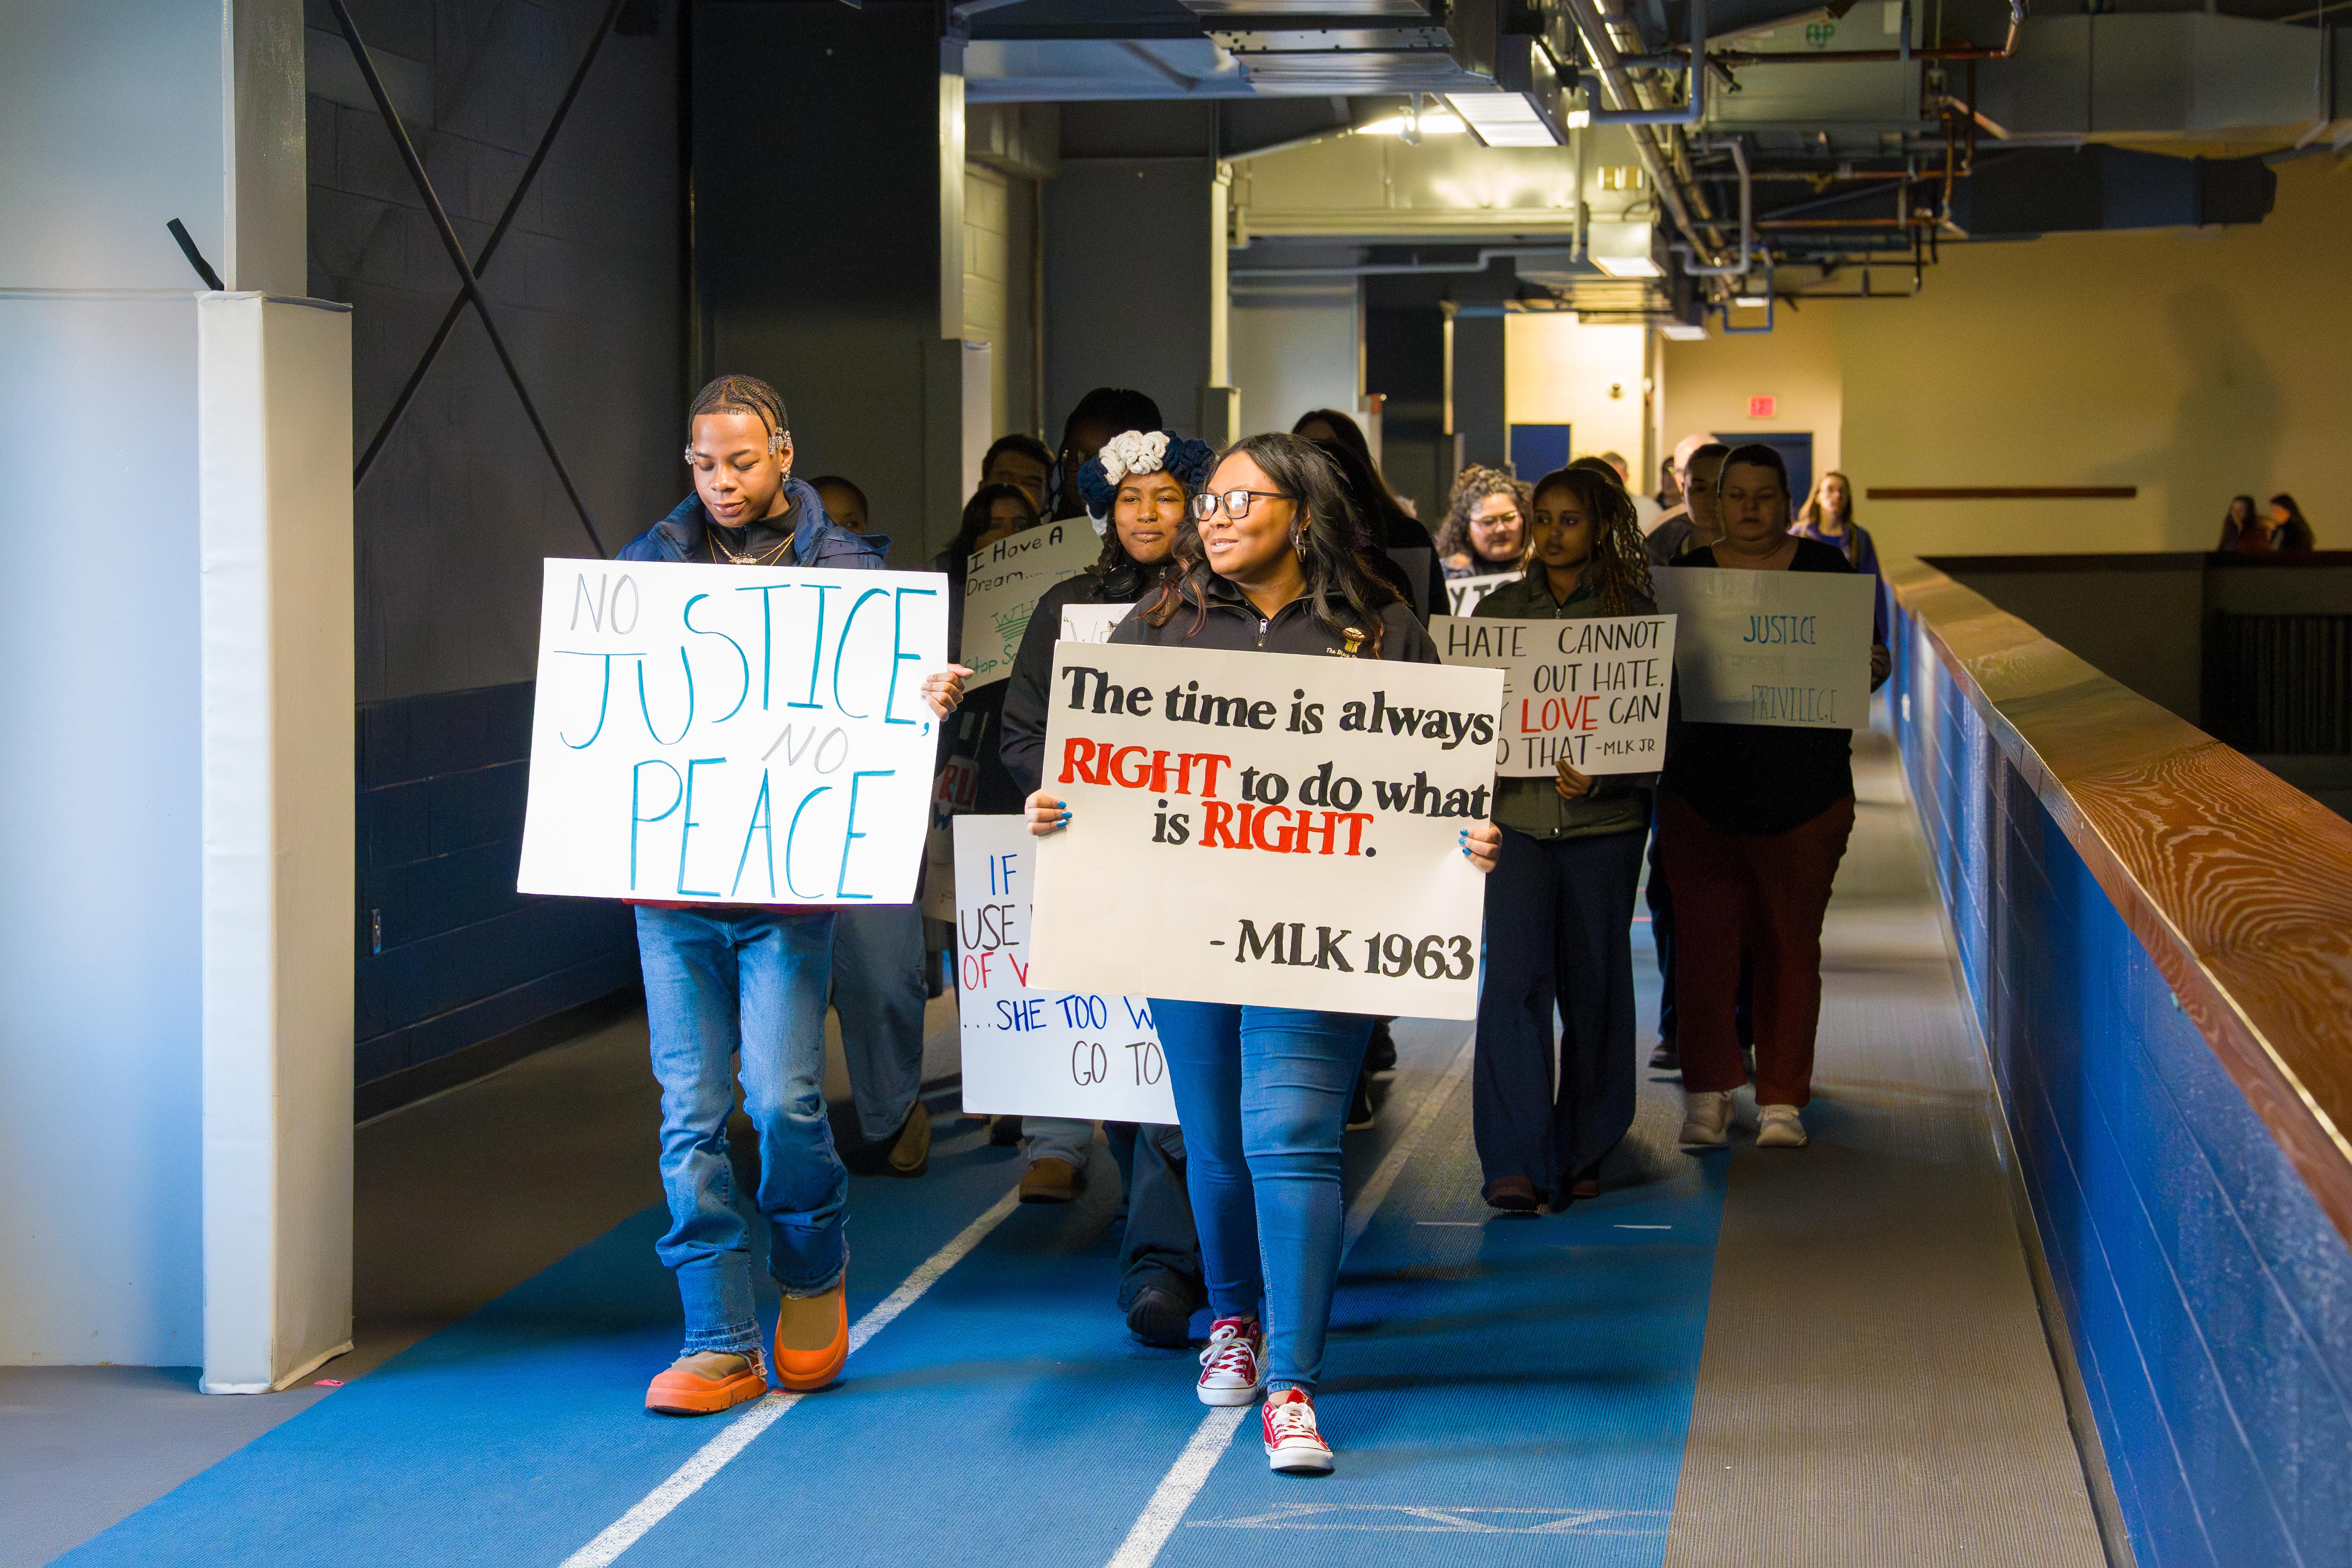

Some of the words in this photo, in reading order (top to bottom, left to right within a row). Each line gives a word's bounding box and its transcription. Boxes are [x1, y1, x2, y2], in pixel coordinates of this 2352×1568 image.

[969, 552, 984, 574] I
[993, 539, 1042, 563] Have
[1049, 525, 1063, 546] A
[571, 573, 639, 634] NO
[1448, 624, 1527, 657] HATE
[1558, 621, 1665, 654] CANNOT
[1743, 615, 1816, 645] JUSTICE
[553, 584, 937, 749] JUSTICE,
[1533, 663, 1583, 693] OUT
[1593, 659, 1664, 692] HATE.
[1062, 666, 1153, 716] The
[1165, 680, 1275, 730] time
[1286, 688, 1324, 734] is
[1339, 691, 1494, 750] always
[1521, 695, 1600, 733] LOVE
[1609, 693, 1661, 724] CAN
[761, 723, 849, 774] NO
[1521, 734, 1594, 769] THAT
[1639, 739, 1655, 752] JR
[1058, 737, 1231, 798] RIGHT
[1241, 766, 1289, 806] to
[1298, 761, 1363, 810] do
[1373, 770, 1491, 820] what
[631, 757, 895, 898] PEACE
[1152, 799, 1190, 845] is
[1199, 801, 1376, 857] RIGHT.
[990, 854, 1017, 896] IF
[961, 904, 1020, 951] USE
[1235, 919, 1354, 973] MLK
[1364, 932, 1475, 981] 1963
[964, 951, 994, 990] OF
[1056, 994, 1107, 1030] TOO
[1123, 996, 1154, 1030] W
[1072, 1040, 1107, 1086] GO
[1125, 1042, 1163, 1086] TO
